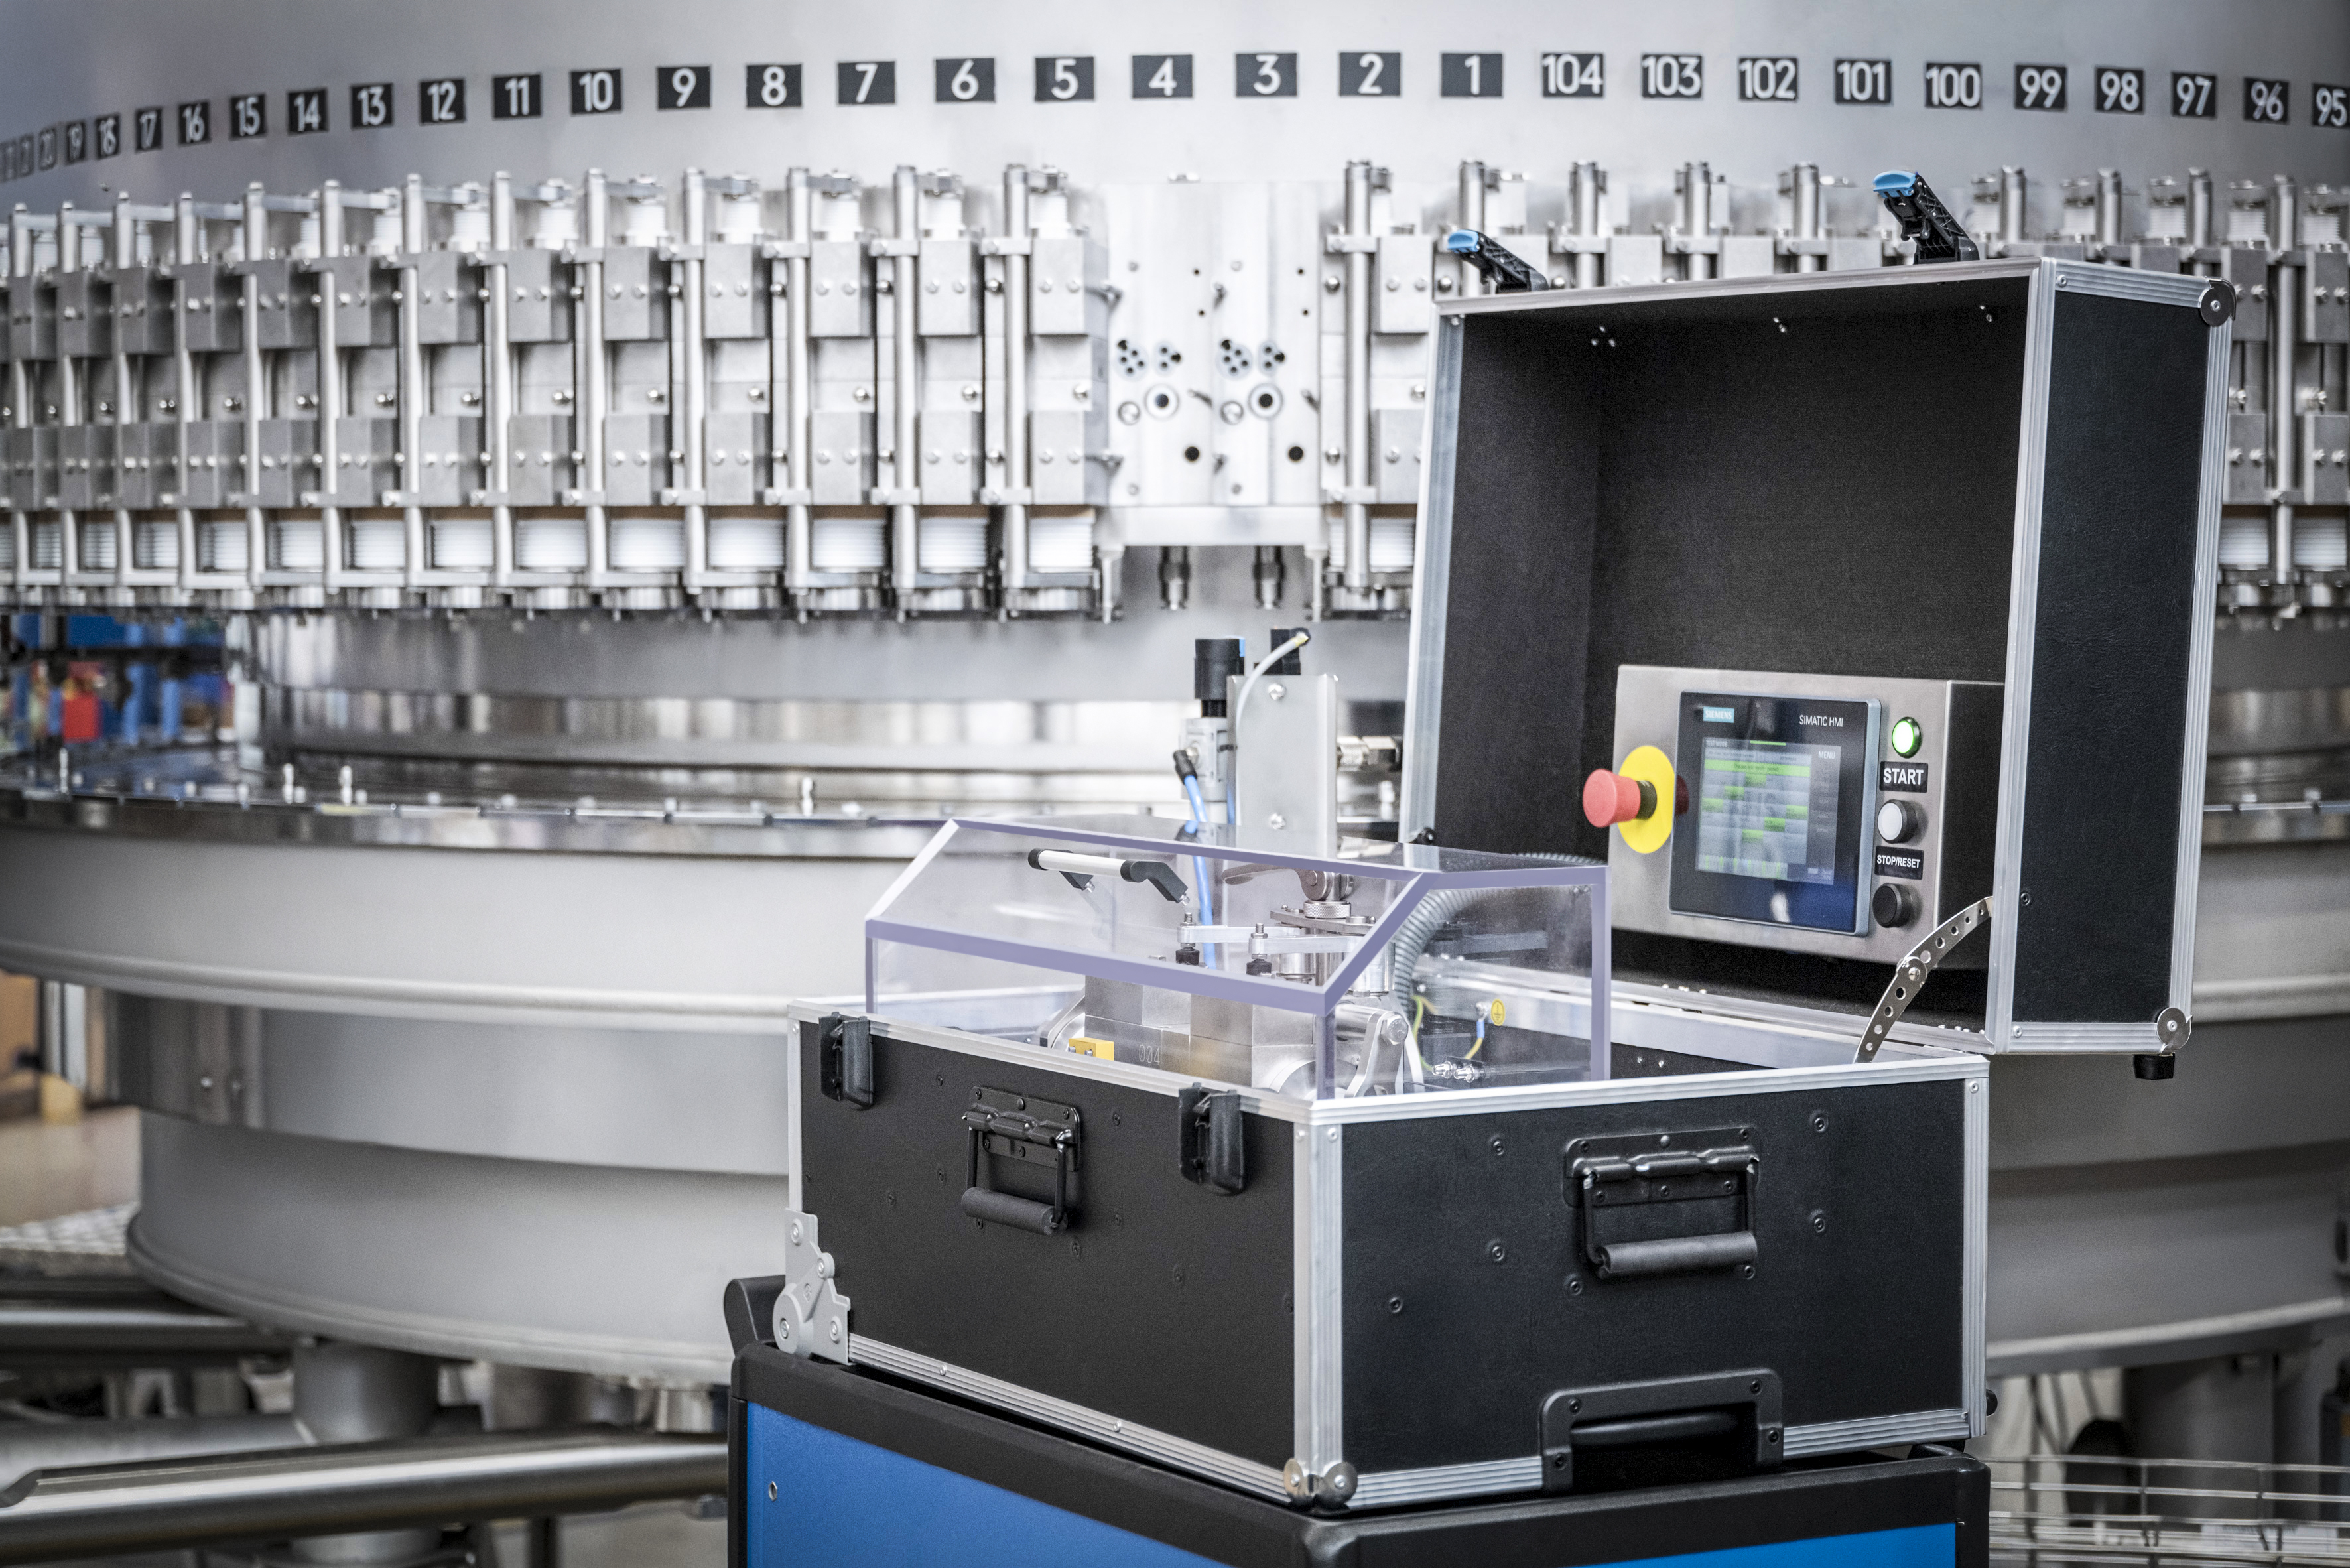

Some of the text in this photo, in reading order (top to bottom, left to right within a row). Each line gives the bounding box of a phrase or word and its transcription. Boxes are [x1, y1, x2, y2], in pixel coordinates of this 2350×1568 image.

[579, 71, 614, 112] 10
[671, 68, 697, 107] 9
[761, 66, 787, 107] 8
[855, 63, 878, 103] 7
[951, 59, 980, 101] 6
[1051, 58, 1079, 99] 5
[1149, 56, 1177, 97] 4
[1253, 54, 1281, 95] 3
[1358, 53, 1384, 94] 2
[1464, 55, 1480, 95] 1
[1541, 53, 1604, 94] 104
[1641, 56, 1701, 96] 103
[1738, 58, 1797, 99] 102
[1836, 61, 1886, 101] 101
[1925, 66, 1981, 107] 100
[2020, 68, 2062, 109] 99
[2100, 70, 2140, 111] 98
[294, 93, 321, 132] 14
[357, 86, 386, 125] 13
[428, 81, 456, 121] 12
[505, 76, 530, 116] 11
[2176, 75, 2213, 115] 97
[2251, 80, 2284, 121] 96
[2316, 87, 2348, 127] 95
[140, 111, 157, 149] 17
[182, 104, 205, 143] 16
[236, 96, 261, 136] 15
[1705, 709, 1732, 720] SIEMENS
[1799, 714, 1843, 728] SIMATIC HMI
[1818, 750, 1836, 759] MENU
[1883, 767, 1924, 785] START
[1876, 854, 1921, 869] STOP/RESET
[1139, 1044, 1160, 1065] 004
